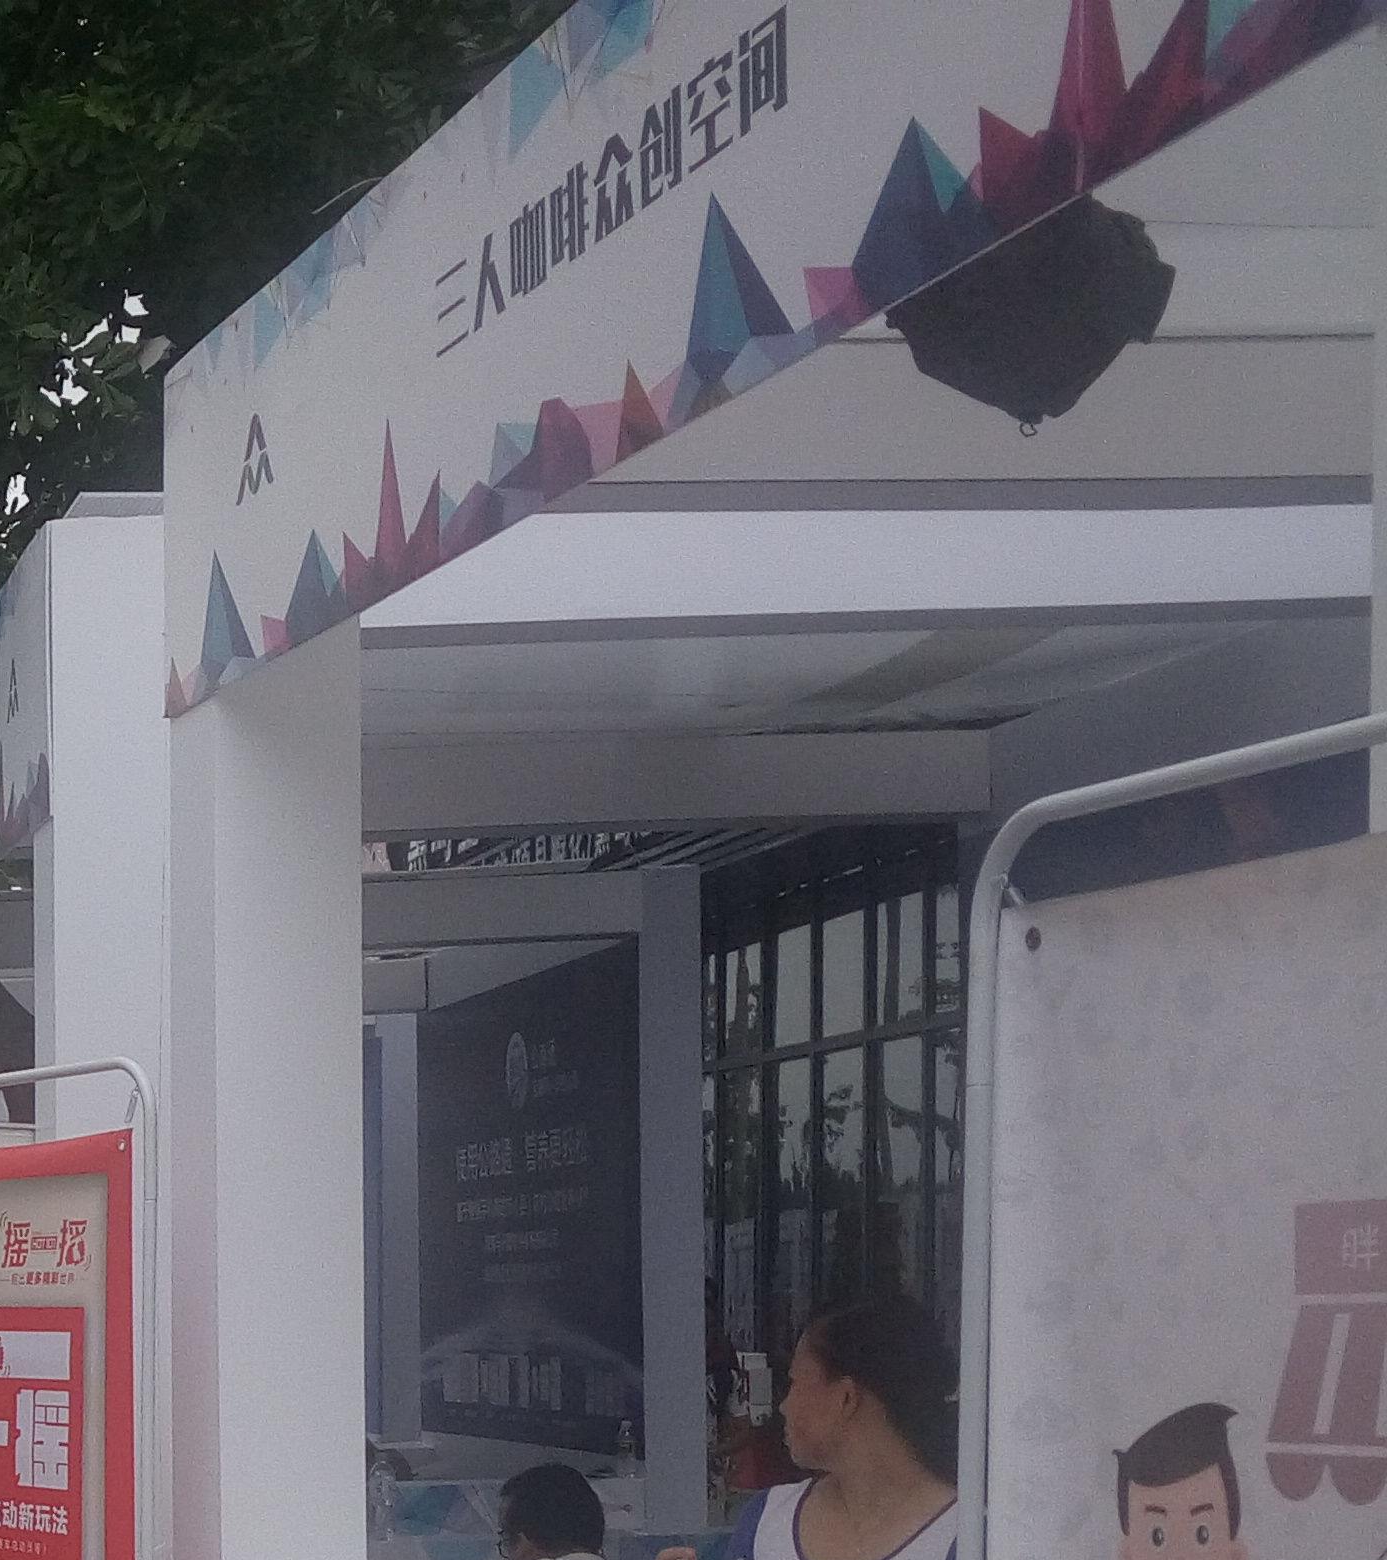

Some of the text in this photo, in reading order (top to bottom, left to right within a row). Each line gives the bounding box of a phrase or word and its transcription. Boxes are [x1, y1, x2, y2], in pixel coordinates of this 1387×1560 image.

[435, 4, 789, 358] 三人咖啡众创空间
